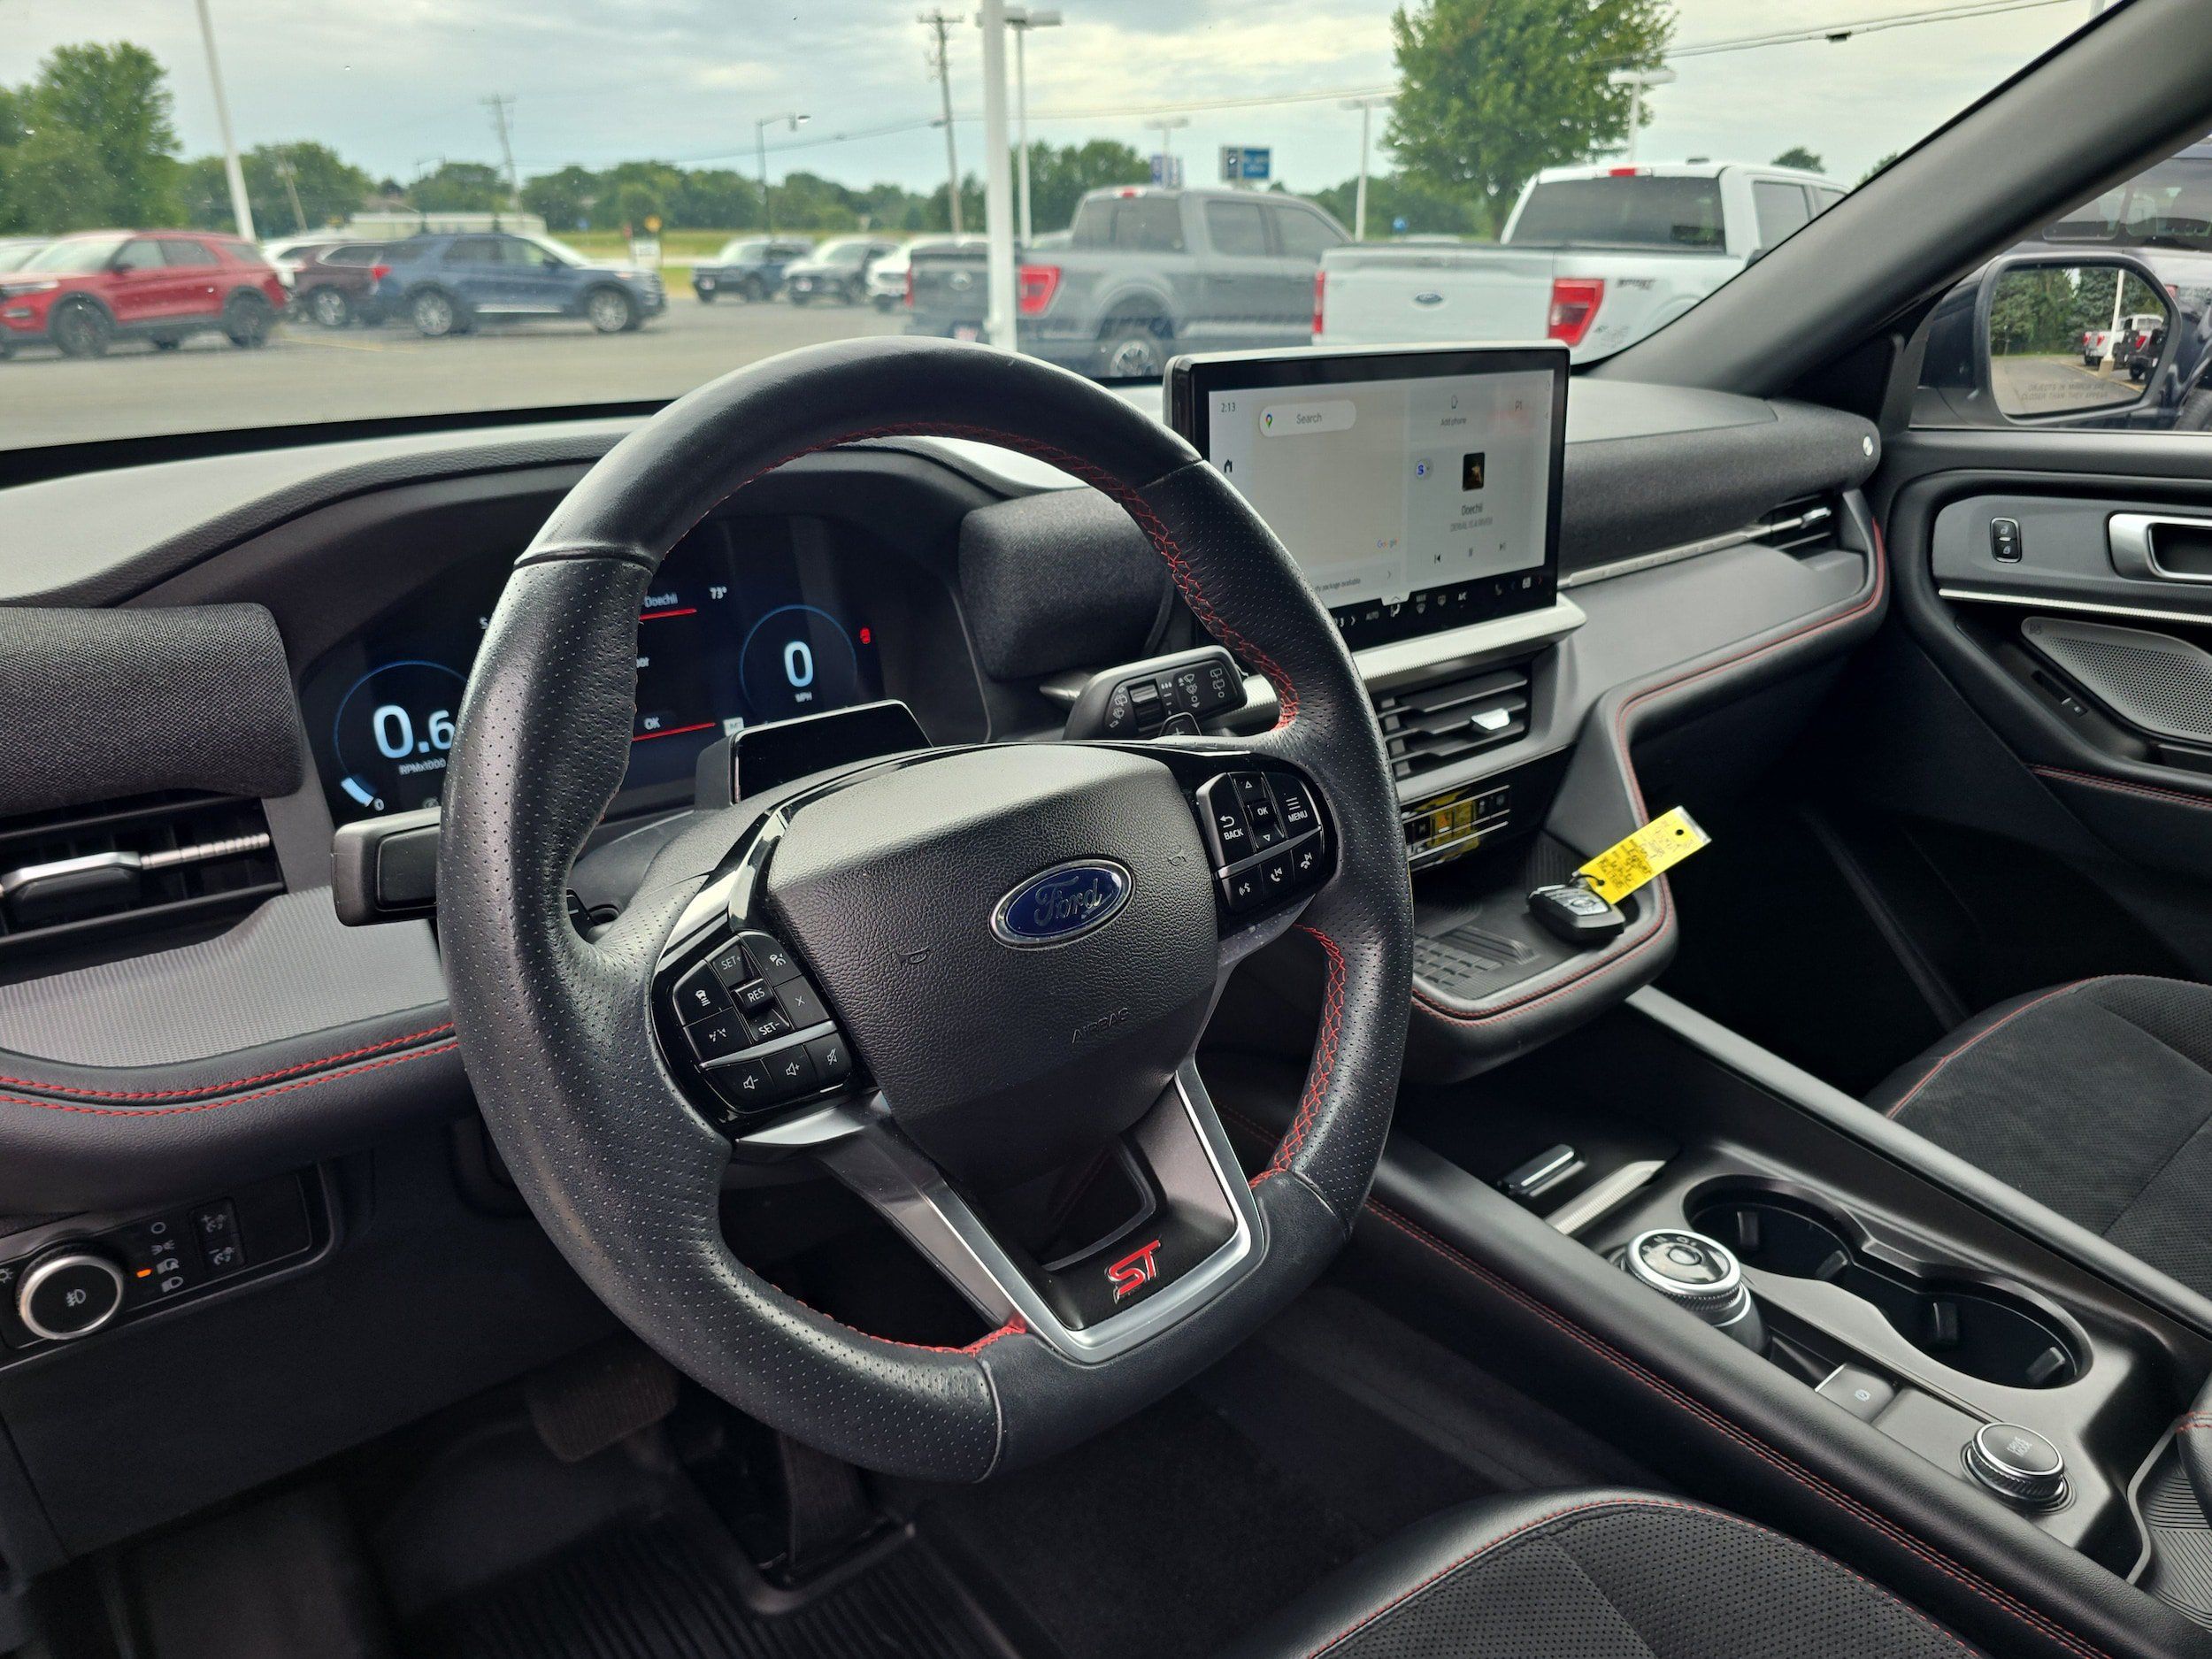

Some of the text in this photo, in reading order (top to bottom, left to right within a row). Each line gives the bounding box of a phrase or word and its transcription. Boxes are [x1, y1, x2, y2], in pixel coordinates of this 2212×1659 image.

[1220, 402, 1236, 413] 2:13
[1295, 413, 1323, 425] Search
[784, 641, 814, 687] 0
[643, 717, 661, 731] OK
[373, 704, 456, 759] 0.6
[1256, 805, 1269, 817] OK
[1287, 810, 1309, 823] MENU
[1223, 828, 1244, 841] BACK
[1033, 876, 1106, 927] Ford
[747, 987, 765, 1002] RES
[1107, 1239, 1162, 1301] ST
